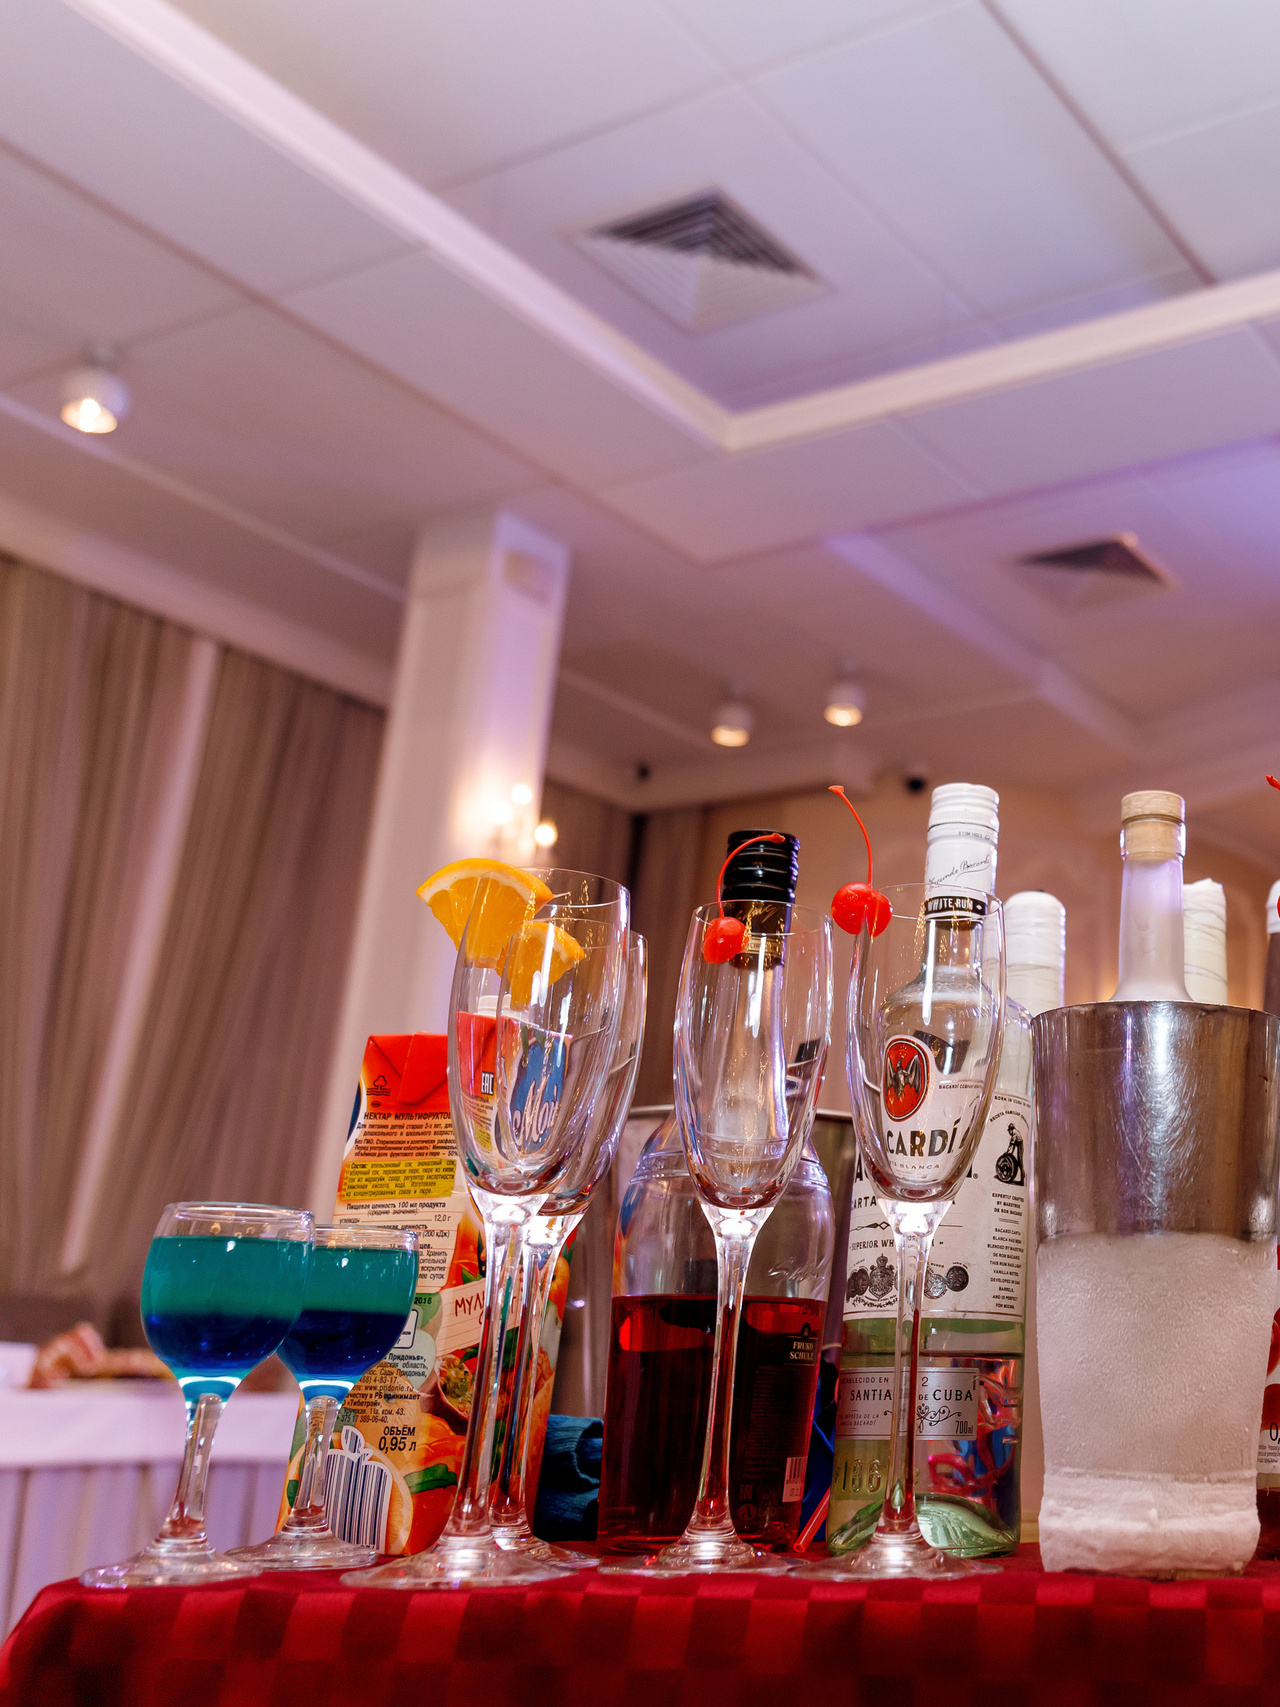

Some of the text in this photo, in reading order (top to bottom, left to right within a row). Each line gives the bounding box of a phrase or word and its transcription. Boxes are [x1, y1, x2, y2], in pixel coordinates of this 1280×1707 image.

[928, 897, 973, 911] WHITE RUM
[364, 1112, 391, 1120] НЕКТАР
[886, 1117, 961, 1157] CARDÍ
[419, 1202, 446, 1210] продукта
[423, 1230, 450, 1238] (200 кДж)
[851, 1240, 878, 1251] SUPERIOR
[793, 1341, 813, 1350] FRUKO
[789, 1351, 814, 1361] SCHULZ
[402, 1361, 428, 1370] область,
[396, 1369, 427, 1378] Придонья,
[850, 1389, 892, 1401] SANTIA
[932, 1389, 973, 1401] CUBA
[383, 1425, 415, 1436] ОБЪЁМ
[955, 1421, 973, 1434] 700ml
[379, 1437, 416, 1453] 0,95 л
[842, 1459, 882, 1493] 186
